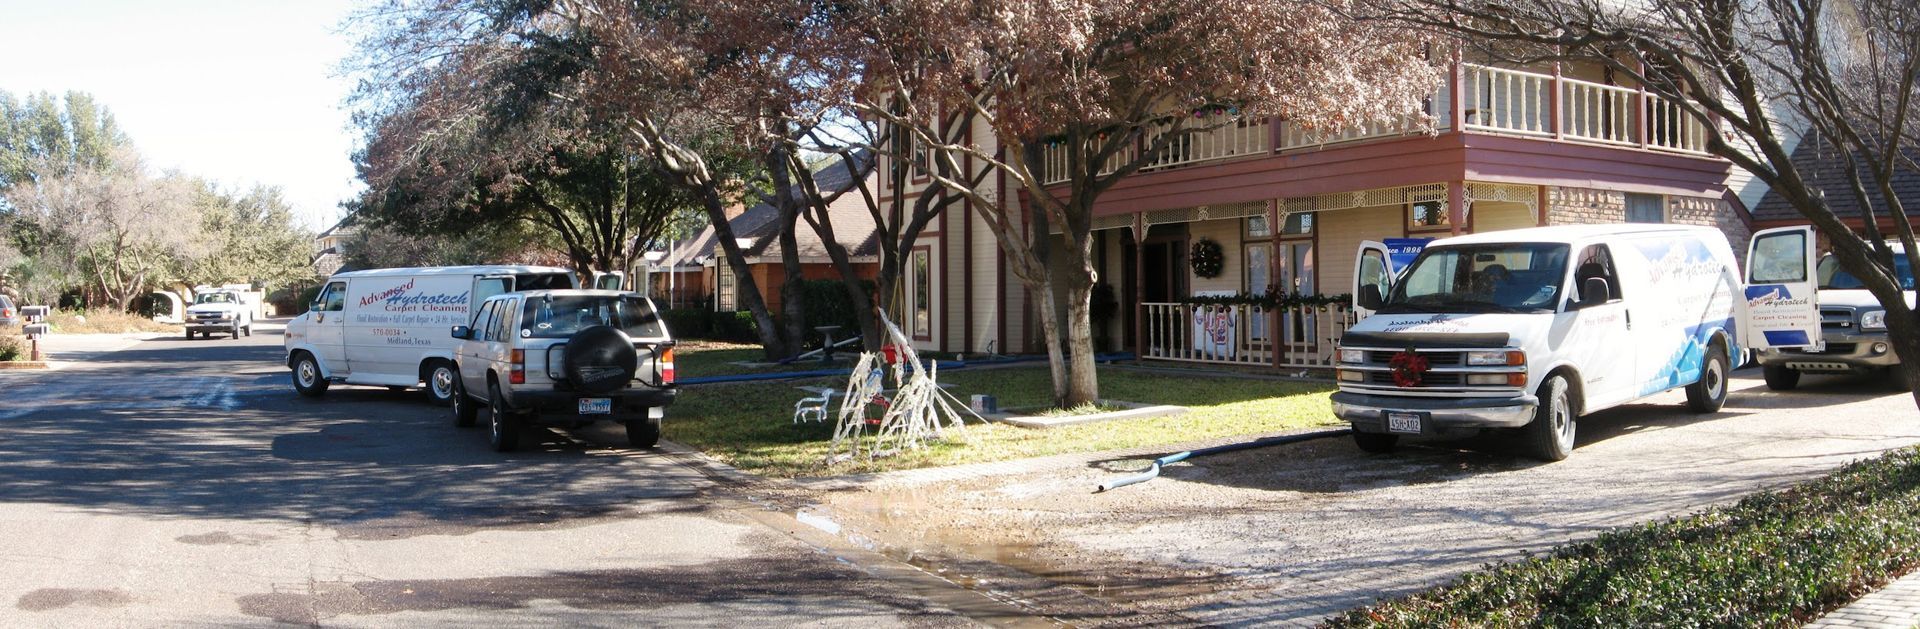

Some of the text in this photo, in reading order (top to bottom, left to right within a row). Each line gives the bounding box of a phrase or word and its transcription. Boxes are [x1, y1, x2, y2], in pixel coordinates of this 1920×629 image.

[359, 278, 414, 308] Advanced
[386, 290, 470, 306] Hydrotech
[385, 304, 468, 313] Carpet Cleaning
[1765, 297, 1808, 308] Hydrotech
